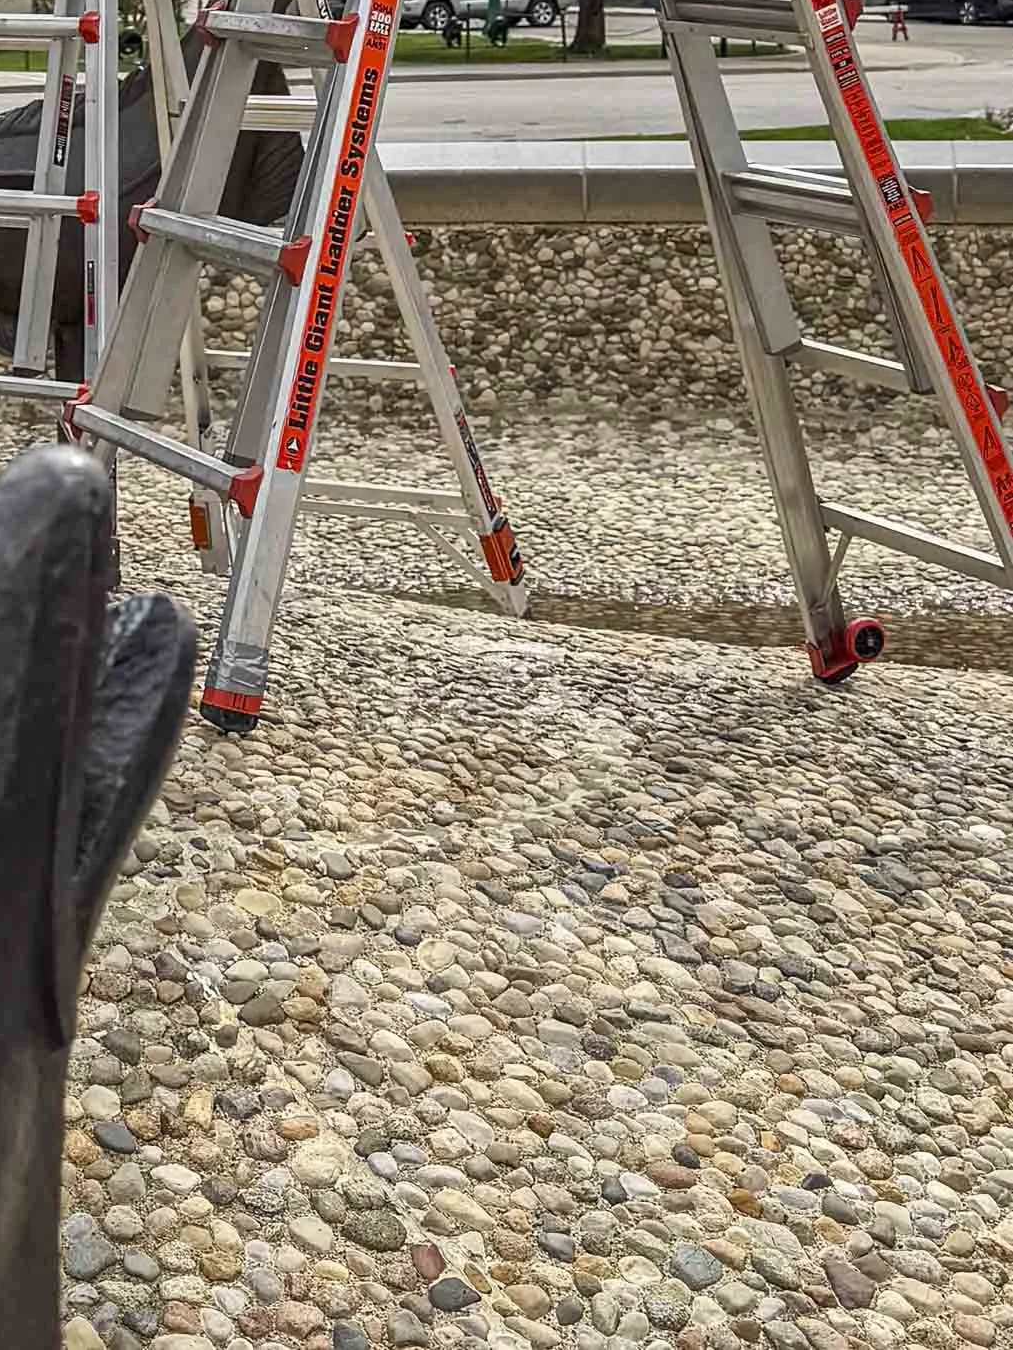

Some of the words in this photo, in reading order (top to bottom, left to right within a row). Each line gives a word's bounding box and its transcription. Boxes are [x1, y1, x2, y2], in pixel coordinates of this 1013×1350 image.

[371, 11, 392, 24] 300
[289, 360, 318, 431] Little
[304, 282, 333, 353] Giant
[321, 185, 355, 279] Ladder
[340, 67, 378, 179] Systems
